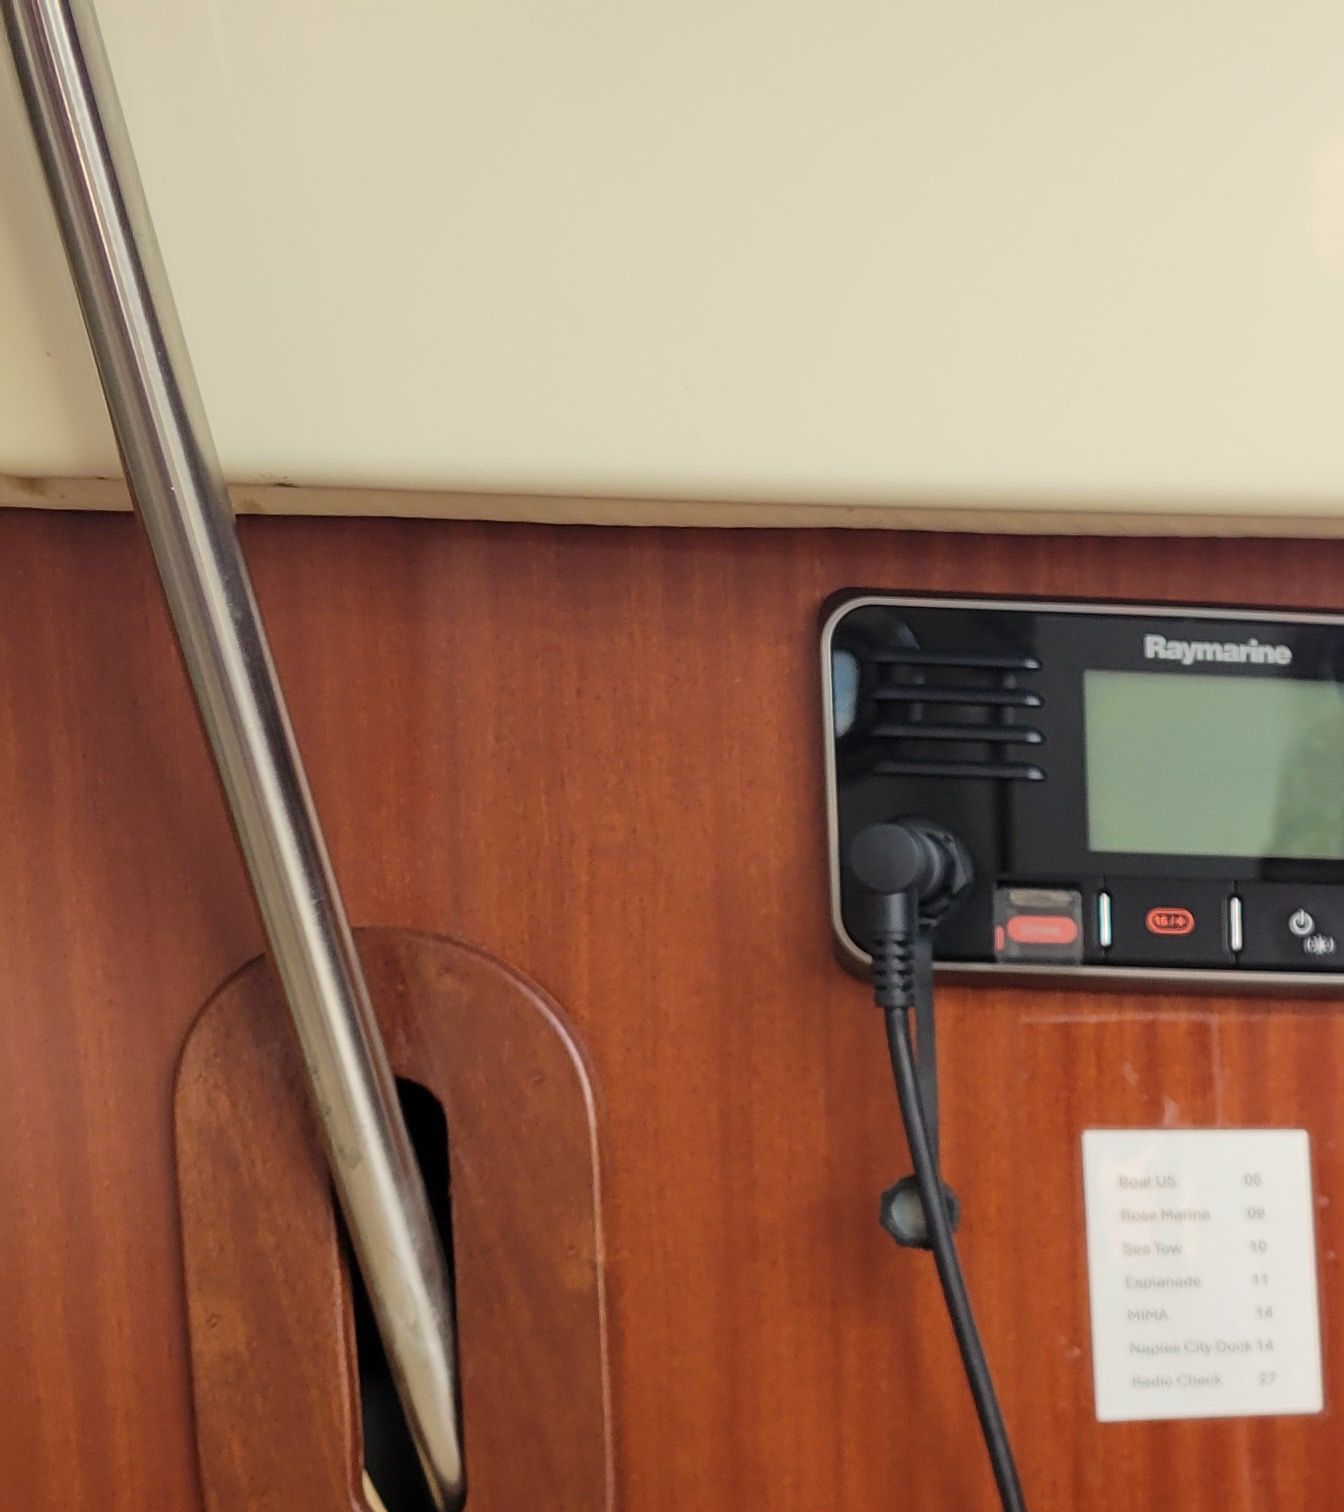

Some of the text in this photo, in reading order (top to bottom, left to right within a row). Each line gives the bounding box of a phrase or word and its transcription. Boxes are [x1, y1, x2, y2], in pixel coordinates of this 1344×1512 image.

[1143, 633, 1293, 665] Raymarine
[1117, 1174, 1151, 1189] Boat
[1155, 1174, 1177, 1188] US
[1120, 1209, 1157, 1222] Rose
[1122, 1241, 1150, 1256] Sea
[1154, 1241, 1183, 1255] Tow
[1124, 1273, 1202, 1290] Esplanade
[1128, 1342, 1180, 1357] Naples
[1183, 1339, 1212, 1356] City
[1215, 1338, 1253, 1353] Dock
[1131, 1374, 1173, 1389] Radio
[1176, 1372, 1223, 1388] Check
